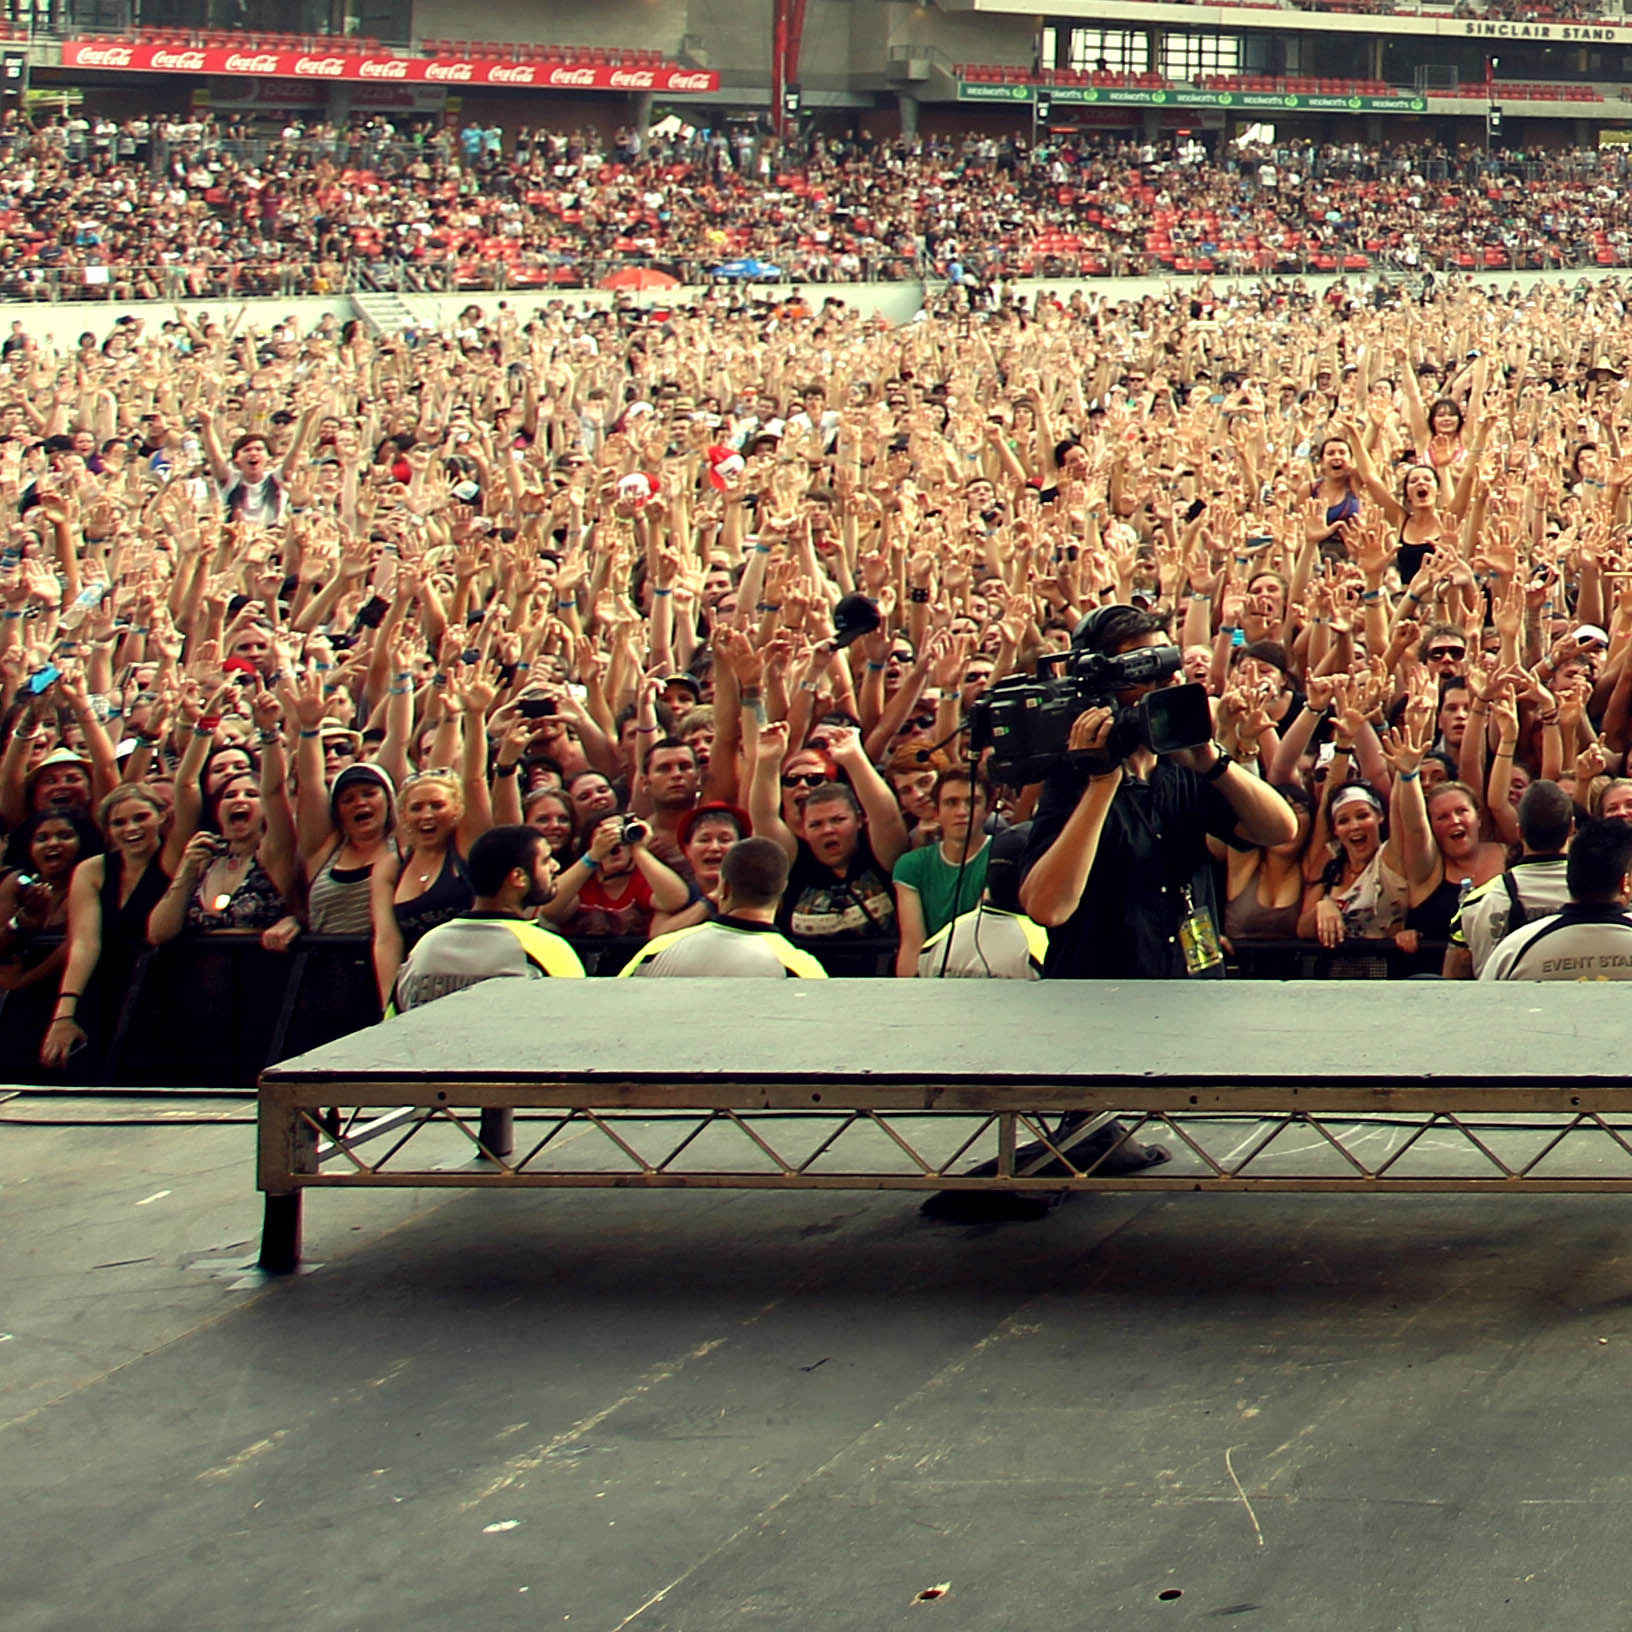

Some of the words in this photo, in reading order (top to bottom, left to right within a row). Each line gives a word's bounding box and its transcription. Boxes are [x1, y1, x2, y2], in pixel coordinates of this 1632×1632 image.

[1466, 22, 1551, 37] SINCLAIR
[1562, 27, 1615, 40] STAND
[966, 86, 1010, 97] woolworths
[1109, 91, 1151, 101] woolworths
[1176, 93, 1217, 103] woolworths
[1243, 96, 1283, 106] woolworths
[1308, 98, 1347, 108] woolworths
[1371, 99, 1409, 109] woolworths
[1542, 955, 1595, 973] EVENT
